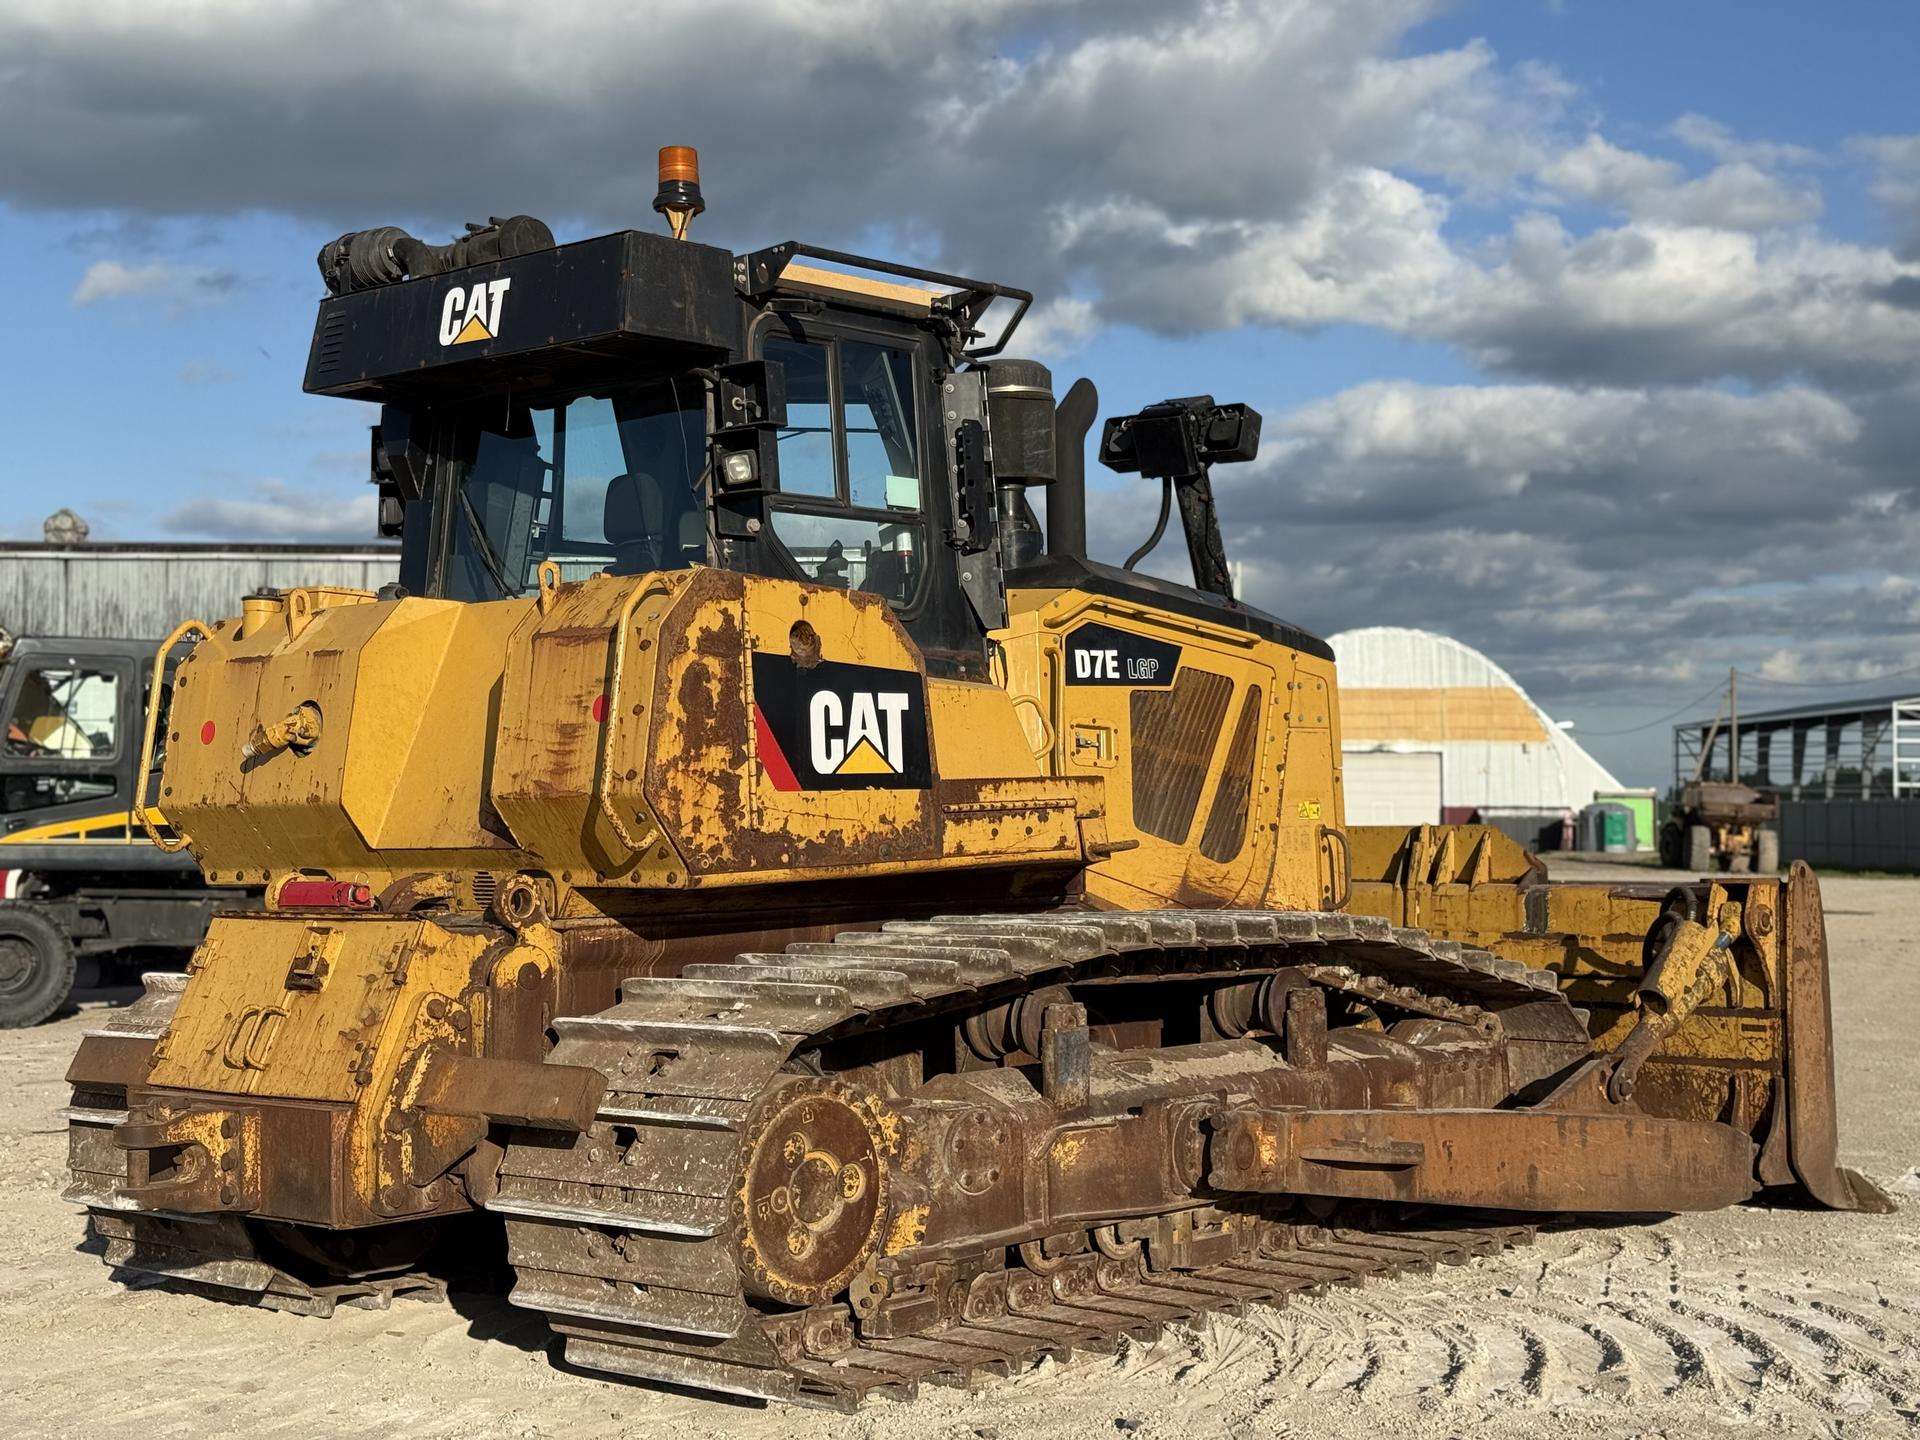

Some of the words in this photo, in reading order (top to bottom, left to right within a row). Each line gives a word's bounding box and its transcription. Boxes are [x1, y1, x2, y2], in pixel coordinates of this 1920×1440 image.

[439, 277, 511, 346] CAT
[1074, 649, 1120, 679] D7E
[1127, 658, 1159, 679] LGP
[809, 690, 909, 774] CAT
